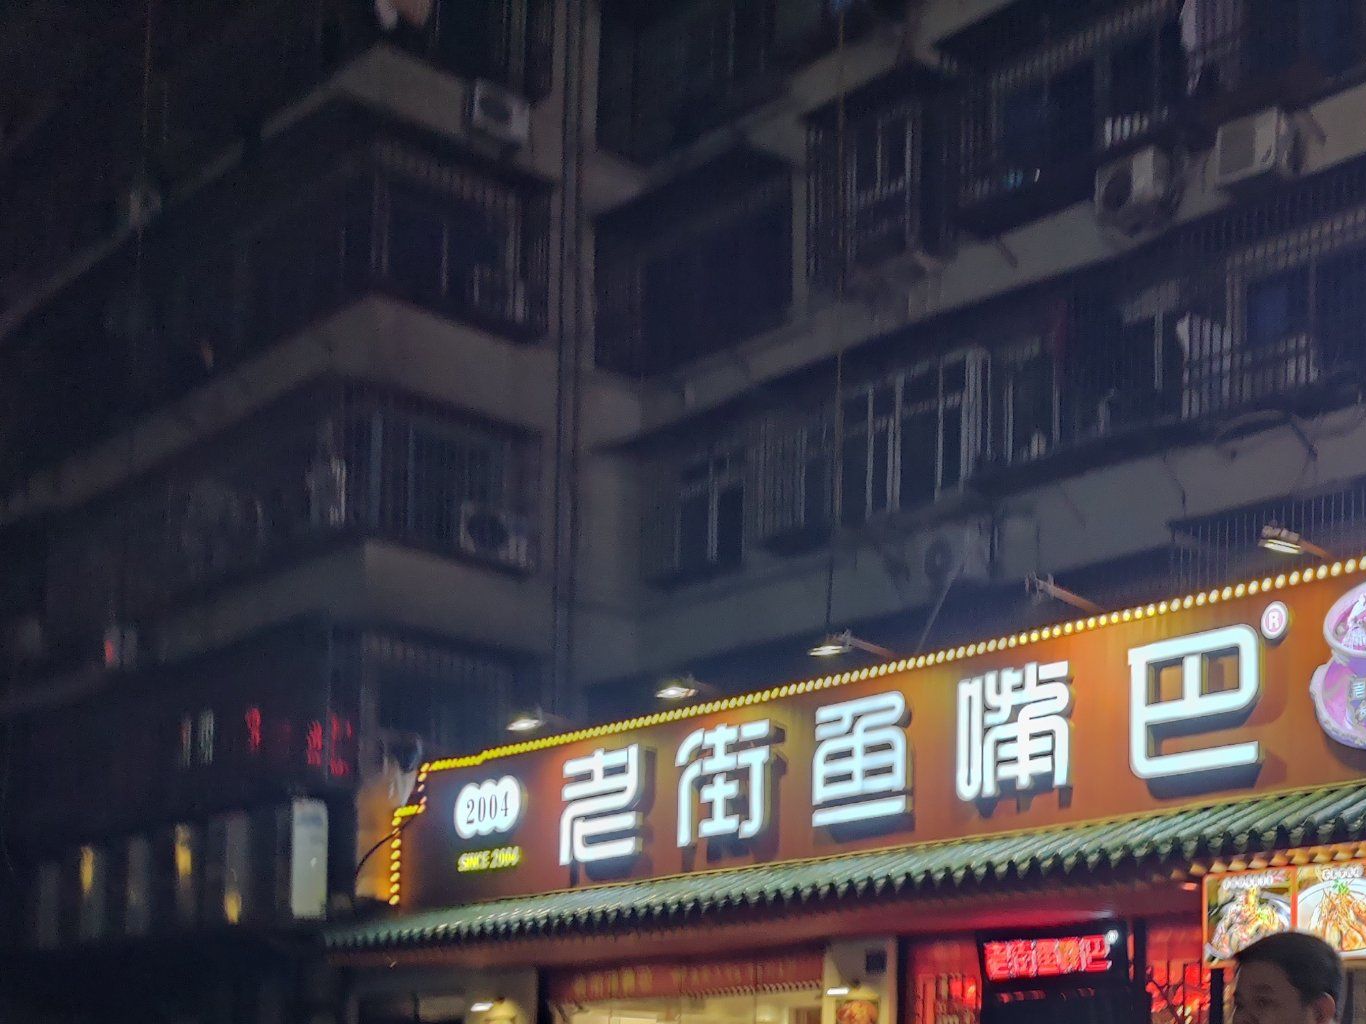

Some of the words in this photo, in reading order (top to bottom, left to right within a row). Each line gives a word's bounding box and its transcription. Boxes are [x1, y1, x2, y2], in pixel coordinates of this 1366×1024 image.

[466, 791, 509, 824] 2004
[559, 623, 1261, 866] 老街鱼嘴巴
